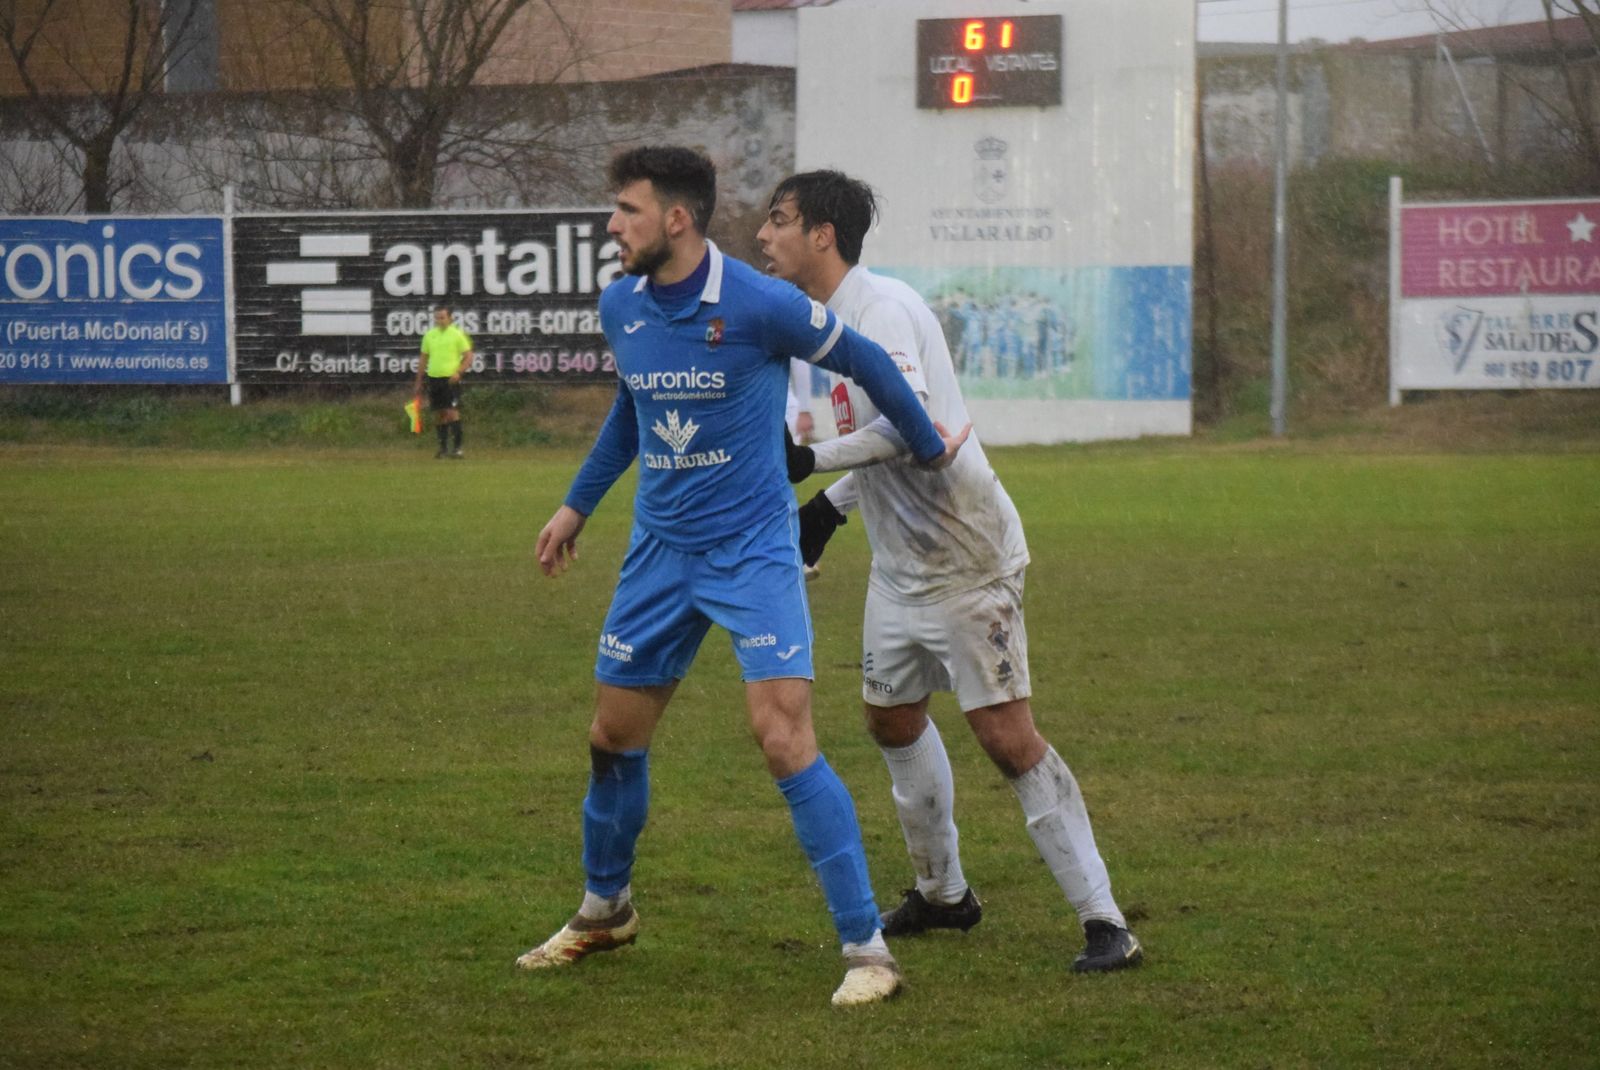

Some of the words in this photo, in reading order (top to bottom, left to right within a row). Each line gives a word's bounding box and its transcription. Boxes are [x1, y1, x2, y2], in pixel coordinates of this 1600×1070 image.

[929, 55, 975, 74] LOCAL
[951, 74, 974, 104] 0
[1437, 213, 1545, 246] HOTEL
[0, 225, 204, 300] onics
[7, 320, 80, 345] (Puerta
[386, 304, 479, 336] cocias
[486, 310, 531, 335] con
[20, 353, 50, 369] 913
[69, 353, 209, 370] www.euronics.es
[309, 353, 371, 374] Santa
[379, 353, 428, 374] Tere
[512, 352, 553, 373] 980
[557, 352, 597, 373] 540
[601, 352, 616, 373] 2
[630, 366, 726, 391] euronics
[674, 448, 732, 470] RURAL
